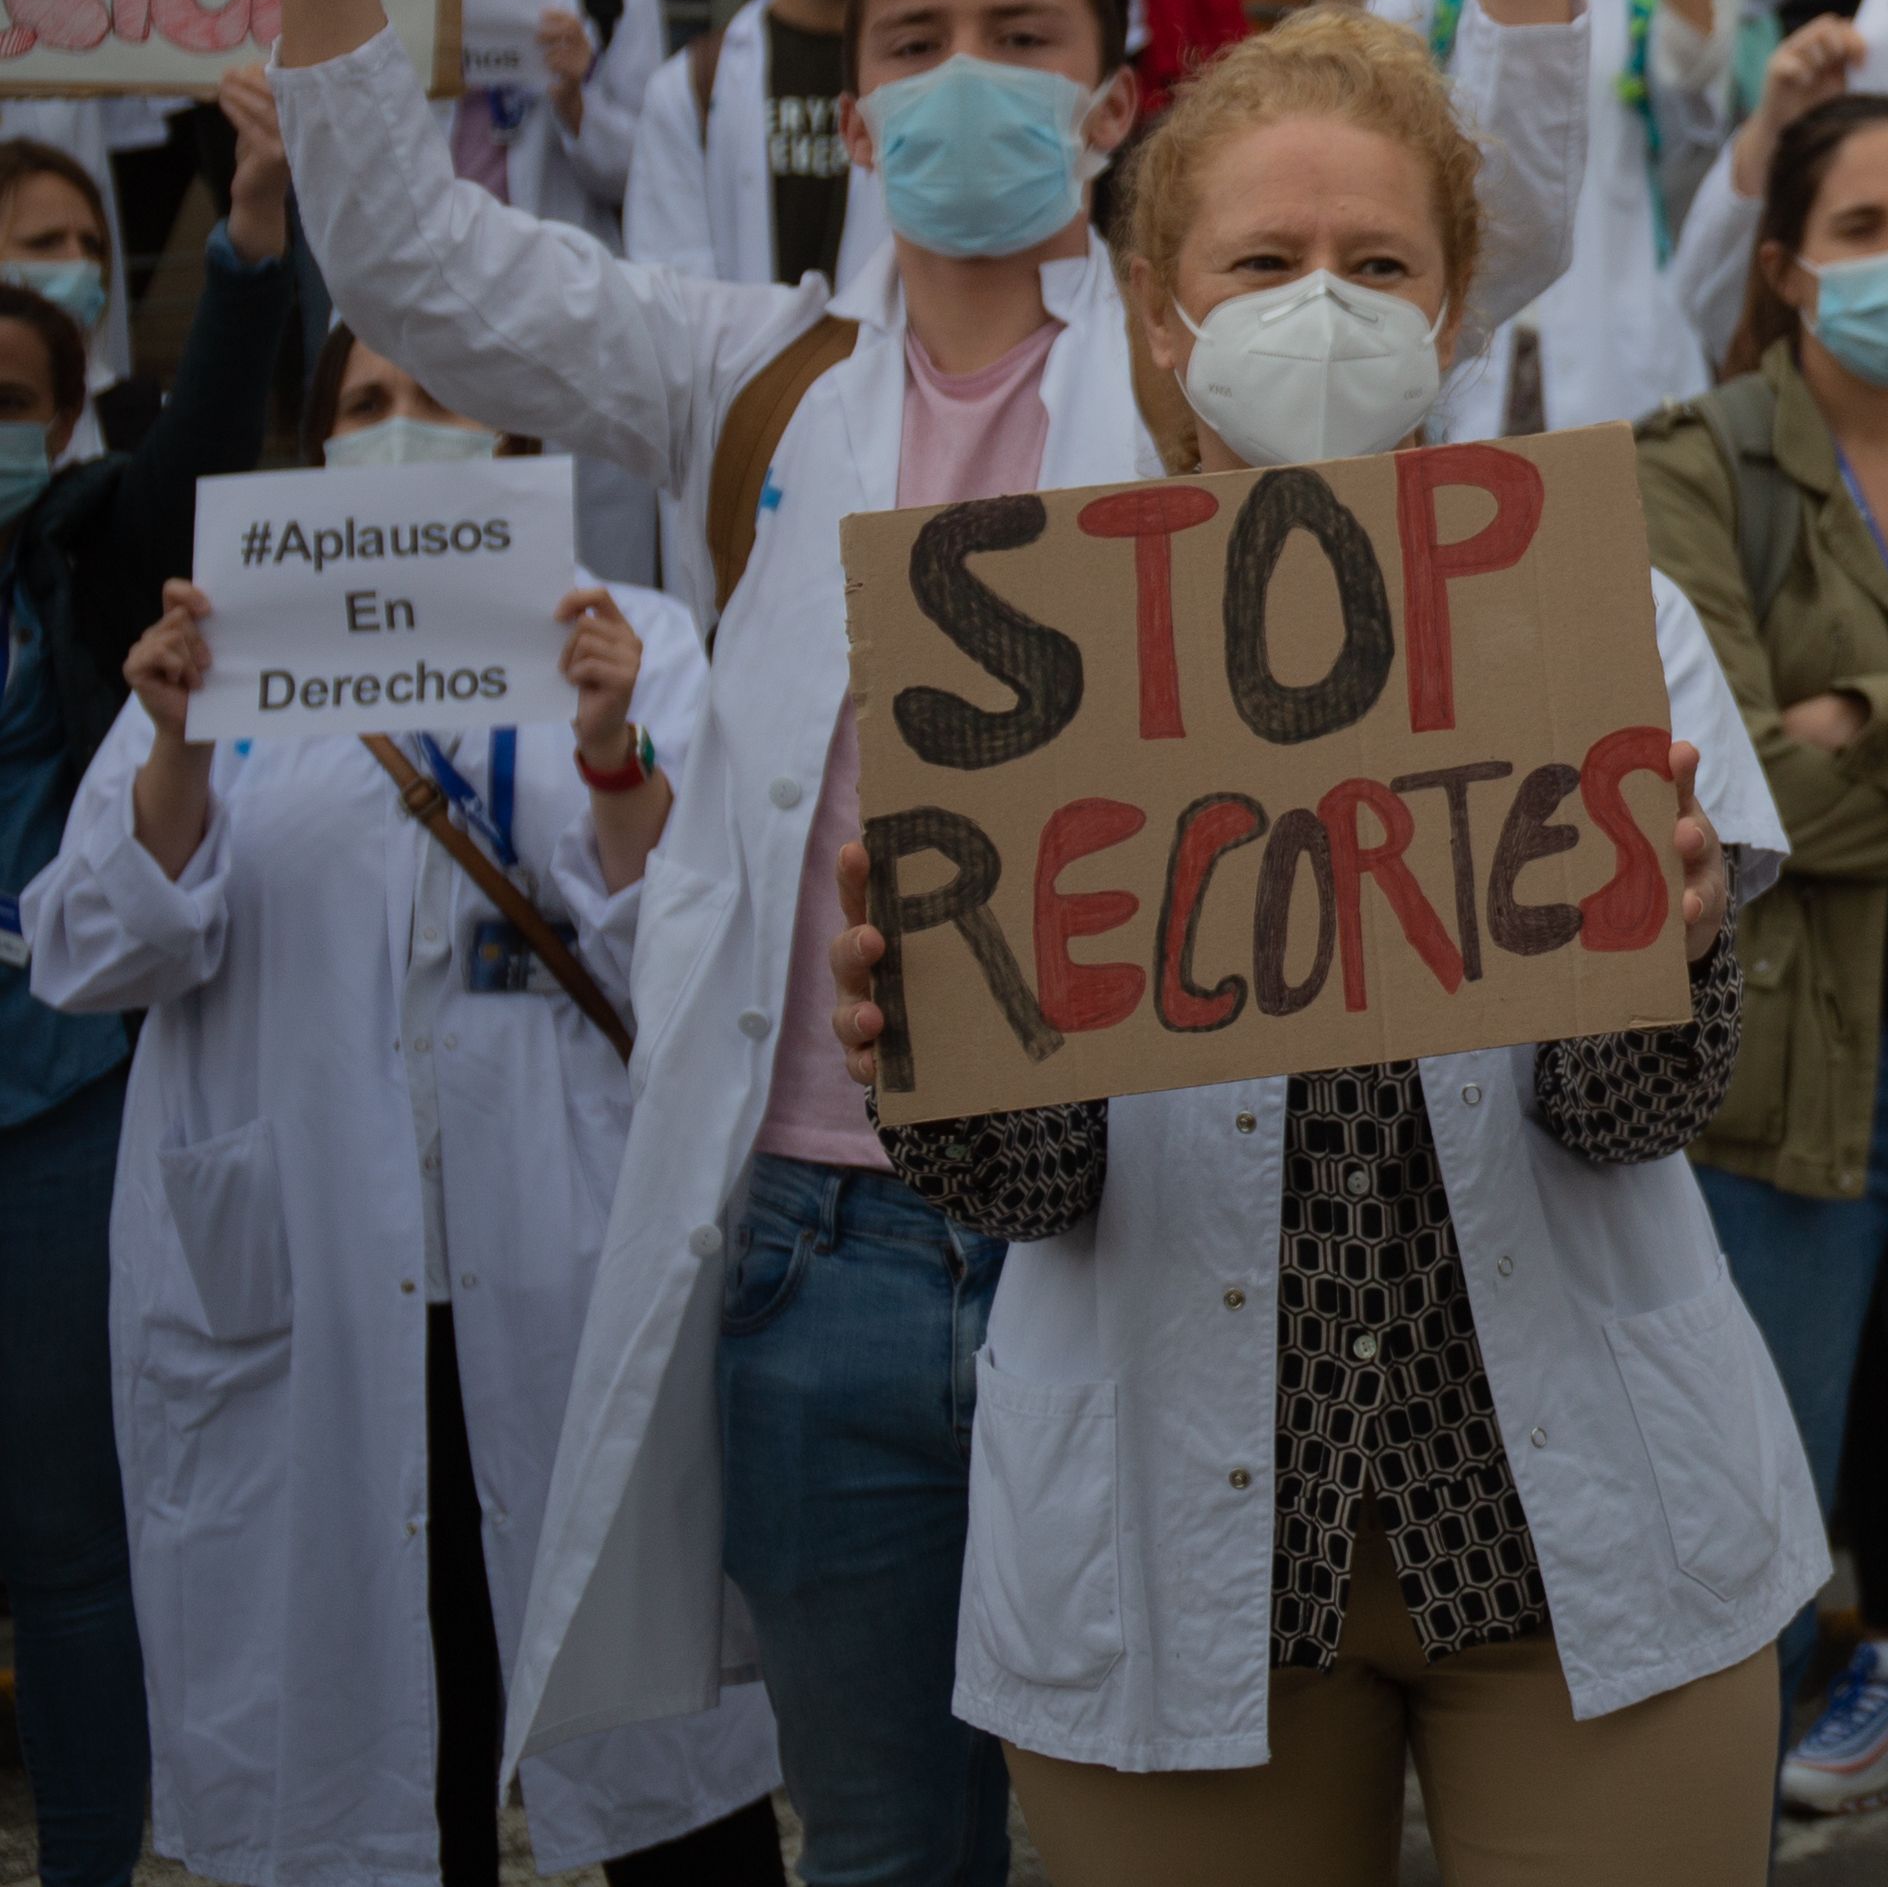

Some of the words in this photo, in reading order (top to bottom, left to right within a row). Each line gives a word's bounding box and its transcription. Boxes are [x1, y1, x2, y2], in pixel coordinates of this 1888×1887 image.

[240, 516, 512, 572] #Aplausos
[344, 589, 417, 633] En
[893, 442, 1545, 770] STOP
[257, 659, 509, 713] Derechos
[865, 725, 1673, 1093] RECORTES
